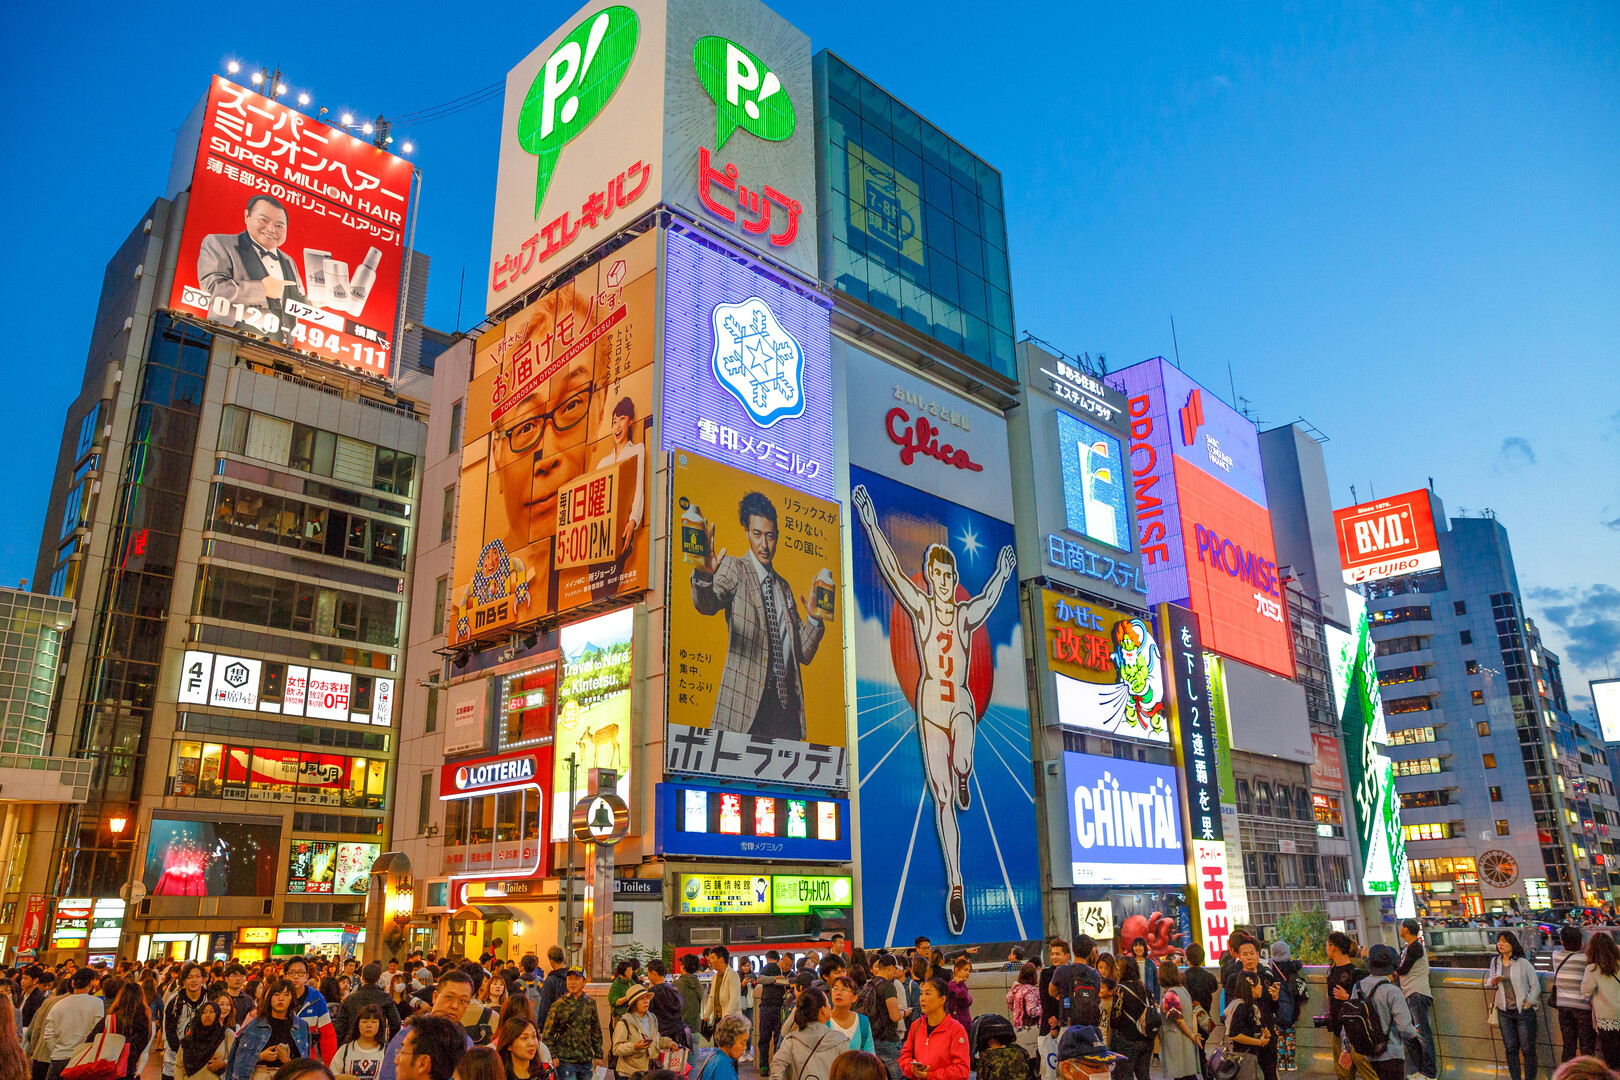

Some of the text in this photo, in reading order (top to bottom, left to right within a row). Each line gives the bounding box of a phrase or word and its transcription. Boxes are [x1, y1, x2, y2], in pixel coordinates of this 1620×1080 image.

[218, 84, 328, 144] スーパー
[214, 109, 404, 202] ミリオンヘアー
[210, 137, 402, 226] SUPER MILLION HAIR
[699, 146, 803, 247] ピップ
[492, 159, 652, 292] ピップエレキバン
[290, 302, 326, 322] ルアン
[212, 296, 387, 370] 0120-494-111
[354, 324, 378, 342] 検索
[500, 378, 538, 413] TOKOROSAN
[539, 338, 590, 383] OTODOKEMONO
[698, 417, 820, 479] 雪印メグミルク
[886, 406, 984, 472] Glico
[784, 497, 837, 525] リラックスが
[784, 516, 828, 542] 足りない、
[1354, 514, 1410, 554] B.V.D.
[784, 535, 828, 560] この国に。
[1194, 522, 1280, 598] PROMISE
[1368, 558, 1419, 577] FUJIBO
[1056, 599, 1104, 632] かぜに
[679, 649, 712, 664] ゆったり
[1052, 625, 1112, 672] 改源
[562, 651, 629, 678] Travel to Nara
[679, 663, 702, 677] 集中、
[936, 630, 955, 703] グリコ
[287, 676, 350, 694] 女性のお客様
[572, 674, 619, 694] Kintetsu.
[678, 678, 713, 694] たっぷり
[324, 693, 349, 710] 0円
[300, 760, 340, 784] 風月
[470, 758, 532, 785] LOTTERIA
[740, 841, 784, 852] 雪印メグミルク
[1200, 847, 1221, 860] スーパー
[320, 883, 332, 892] 2F
[506, 883, 528, 894] Toilets
[622, 882, 651, 892] Toilets
[704, 880, 751, 890] 店舗情報館
[798, 880, 832, 902] ピタットハウス
